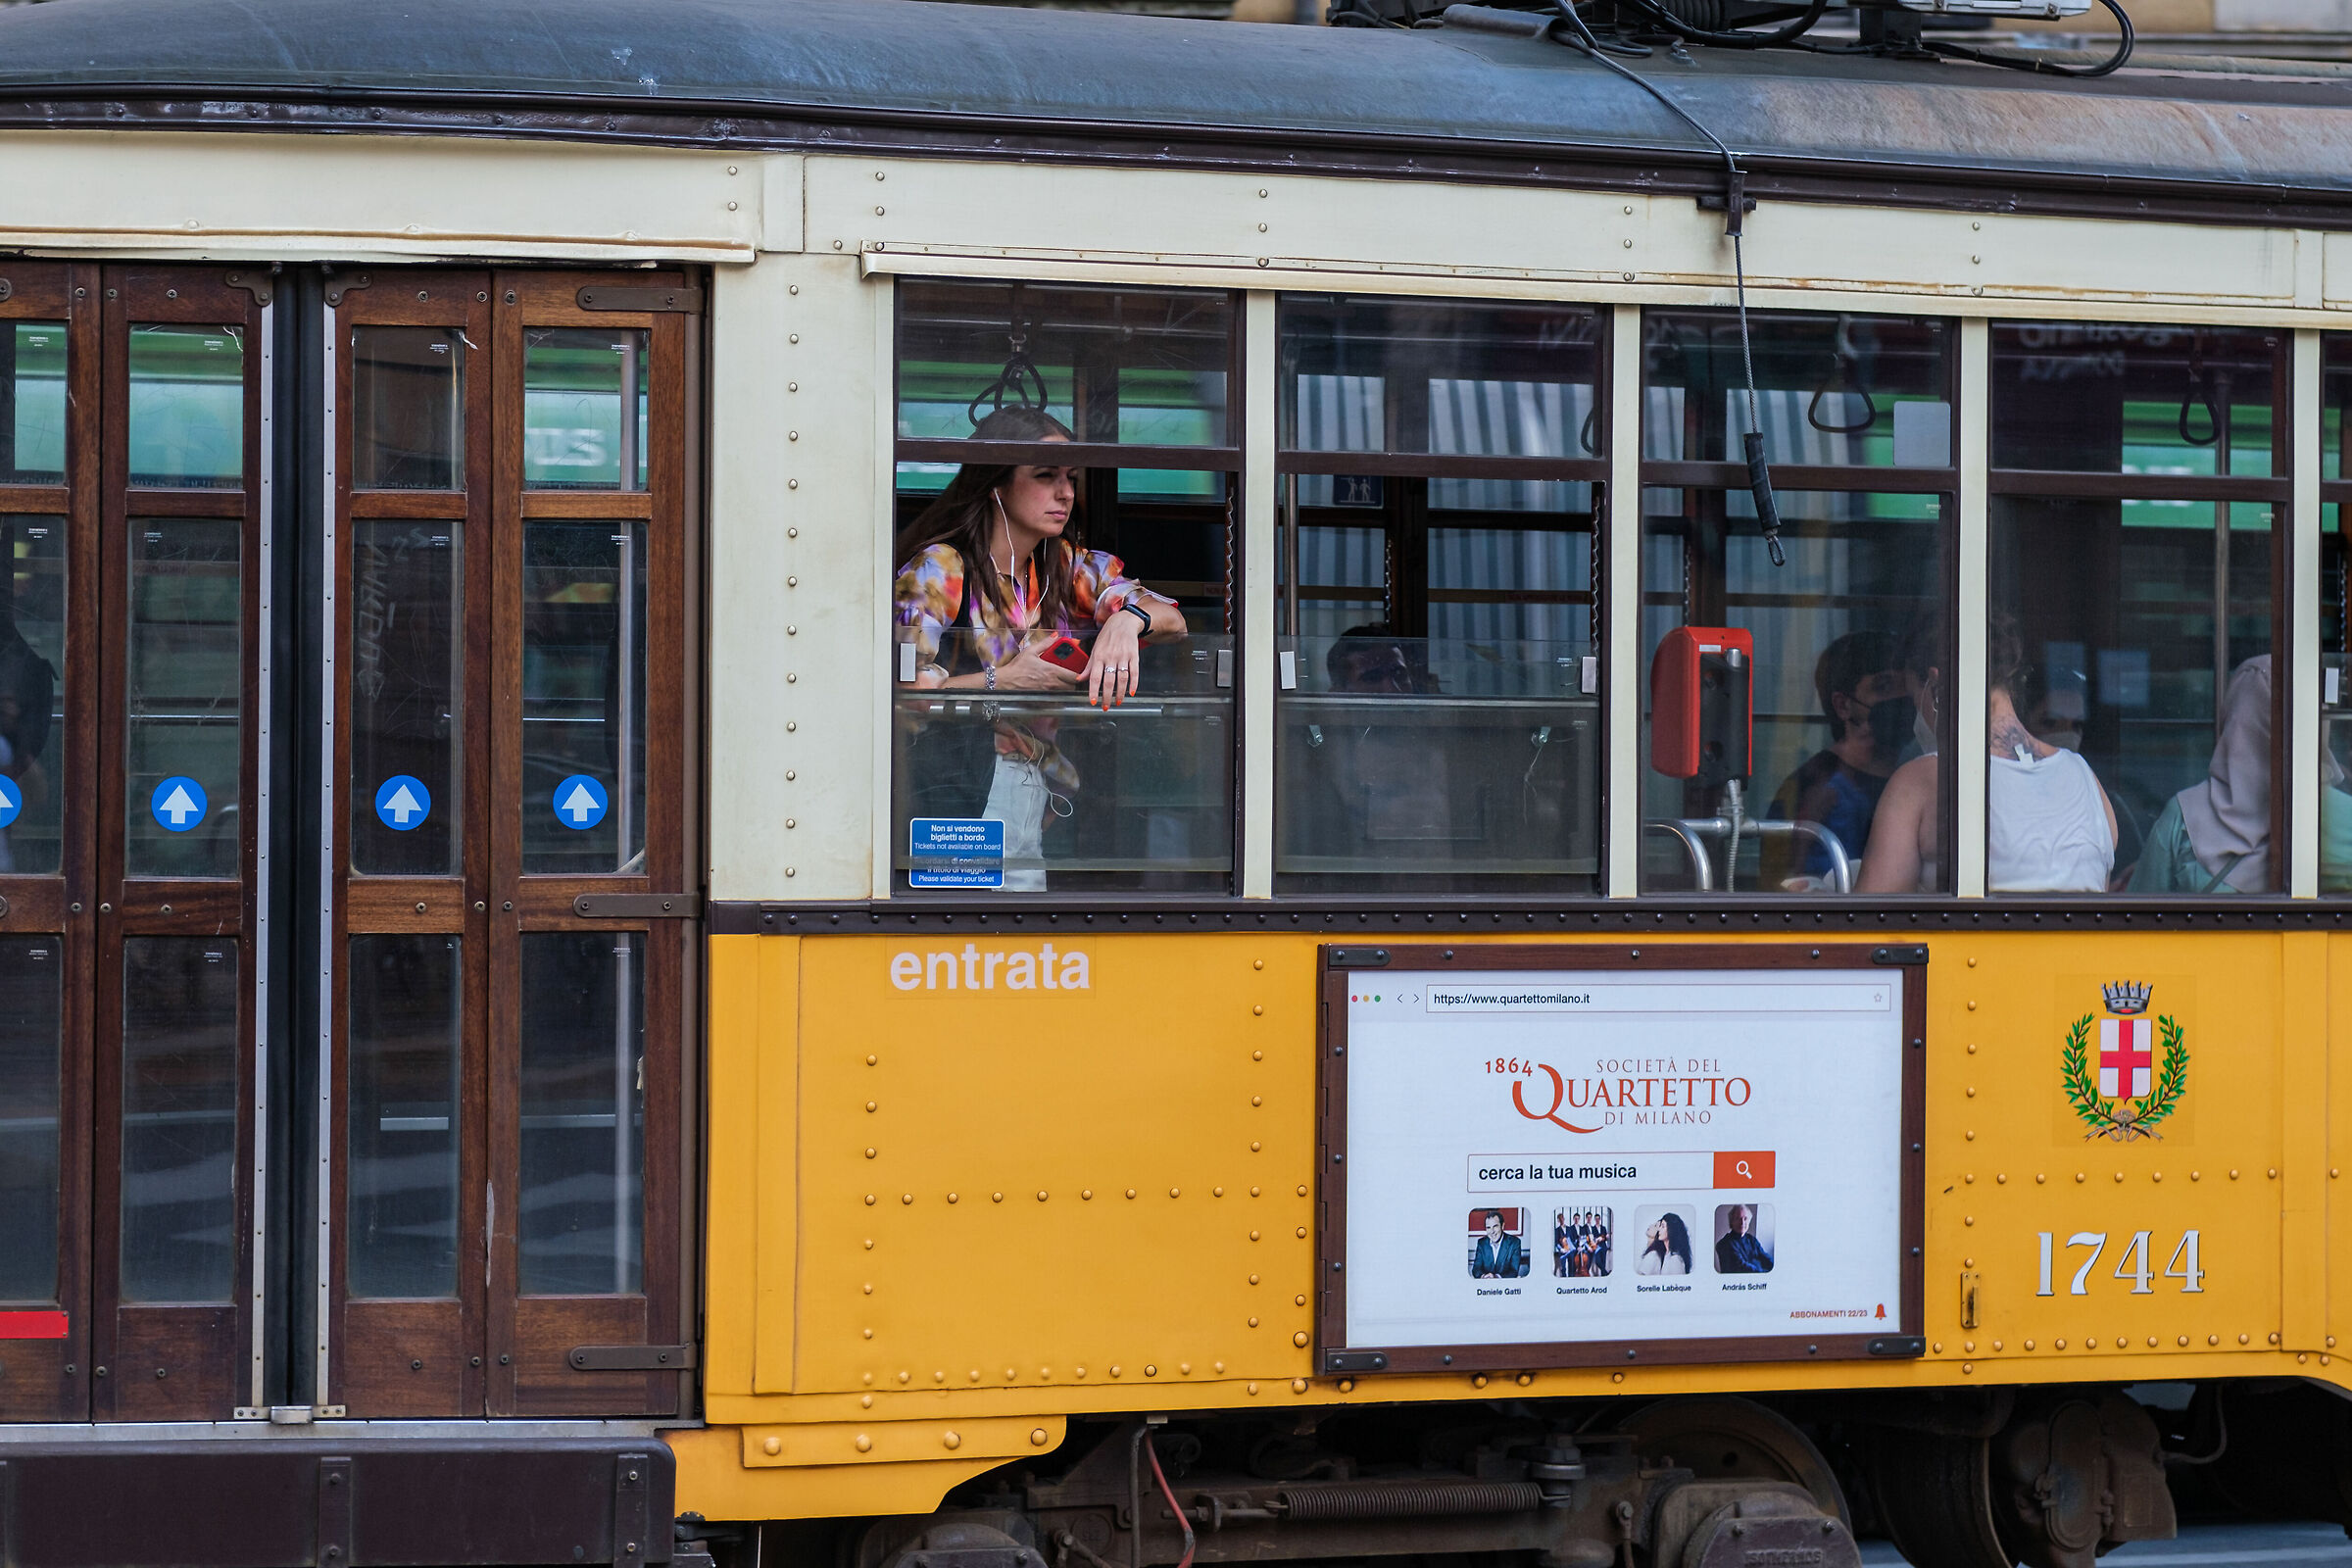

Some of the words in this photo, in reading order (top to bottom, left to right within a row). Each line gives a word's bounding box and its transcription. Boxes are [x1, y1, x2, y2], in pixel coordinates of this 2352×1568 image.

[954, 824, 985, 833] vendono
[930, 833, 956, 842] biglietti
[890, 943, 1091, 991] entrata
[1434, 993, 1591, 1006] https://www.quartettomilano.it
[1485, 1057, 1533, 1077] 1864
[1596, 1056, 1677, 1073] SOCIETÀ
[1688, 1058, 1721, 1073] DEL
[1512, 1063, 1751, 1134] QUARTETTO
[1603, 1111, 1624, 1125] DI
[1635, 1110, 1711, 1125] MILANO
[1478, 1167, 1524, 1180] cerca
[1529, 1164, 1544, 1180] la
[1547, 1164, 1574, 1179] tua
[1579, 1163, 1638, 1179] musica
[2035, 1229, 2205, 1297] 1744
[1476, 1288, 1503, 1297] Daniele
[1556, 1287, 1590, 1296] Quartetto
[1591, 1286, 1608, 1295] Arod
[1661, 1283, 1691, 1293] Labèque
[1721, 1283, 1746, 1292] András
[1747, 1282, 1768, 1291] Schiff
[1789, 1310, 1846, 1319] ABBONAMENTI
